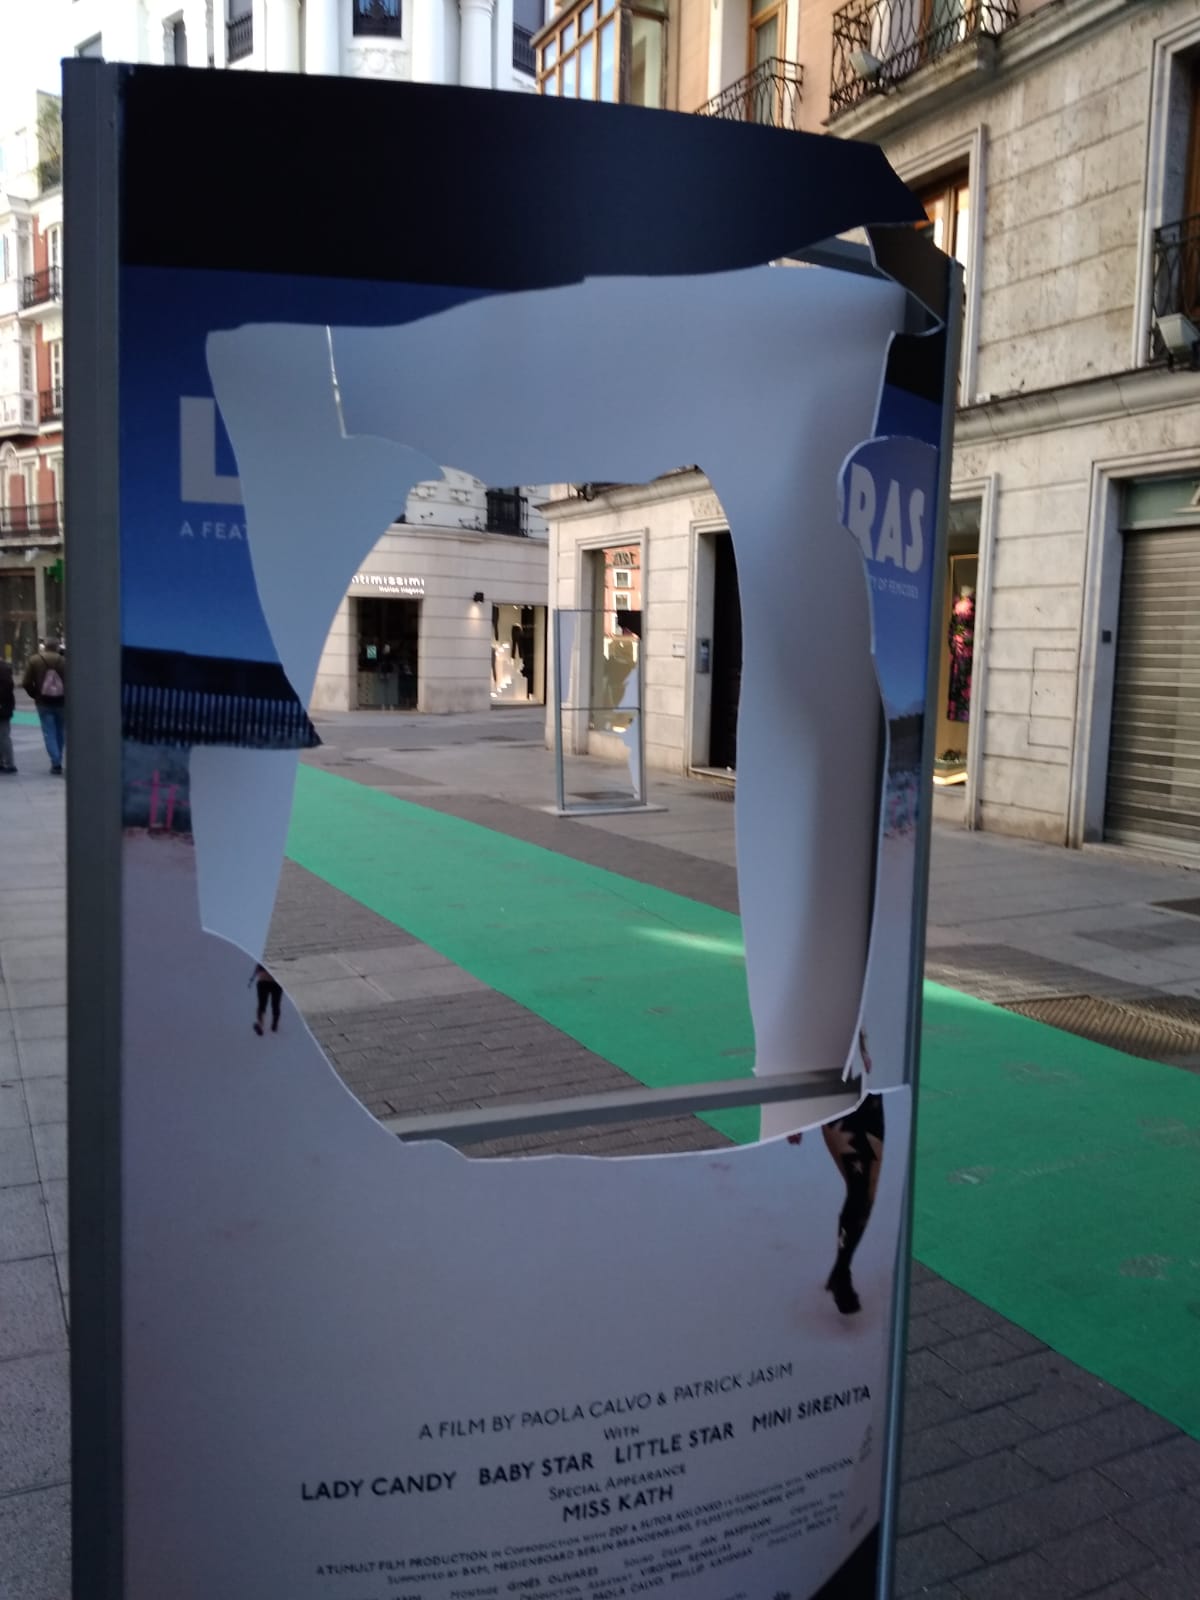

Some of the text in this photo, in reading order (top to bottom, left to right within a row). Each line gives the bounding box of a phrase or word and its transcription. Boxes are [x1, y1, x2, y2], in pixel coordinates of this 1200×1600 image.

[179, 520, 194, 537] A
[351, 574, 425, 587] ntimissimi
[418, 1362, 792, 1440] A FILM BY PAOLA CALVO & PATRICK JASIM
[301, 1385, 870, 1501] LADY CANDY BABY STAR LITTLE STAR MINI SIRENITA
[604, 1426, 639, 1440] WITH
[549, 1464, 687, 1501] SPECIAL APPEARANCE
[563, 1484, 673, 1522] MISS KATH
[377, 1559, 406, 1571] FILM
[409, 1550, 488, 1568] PRODUCTION
